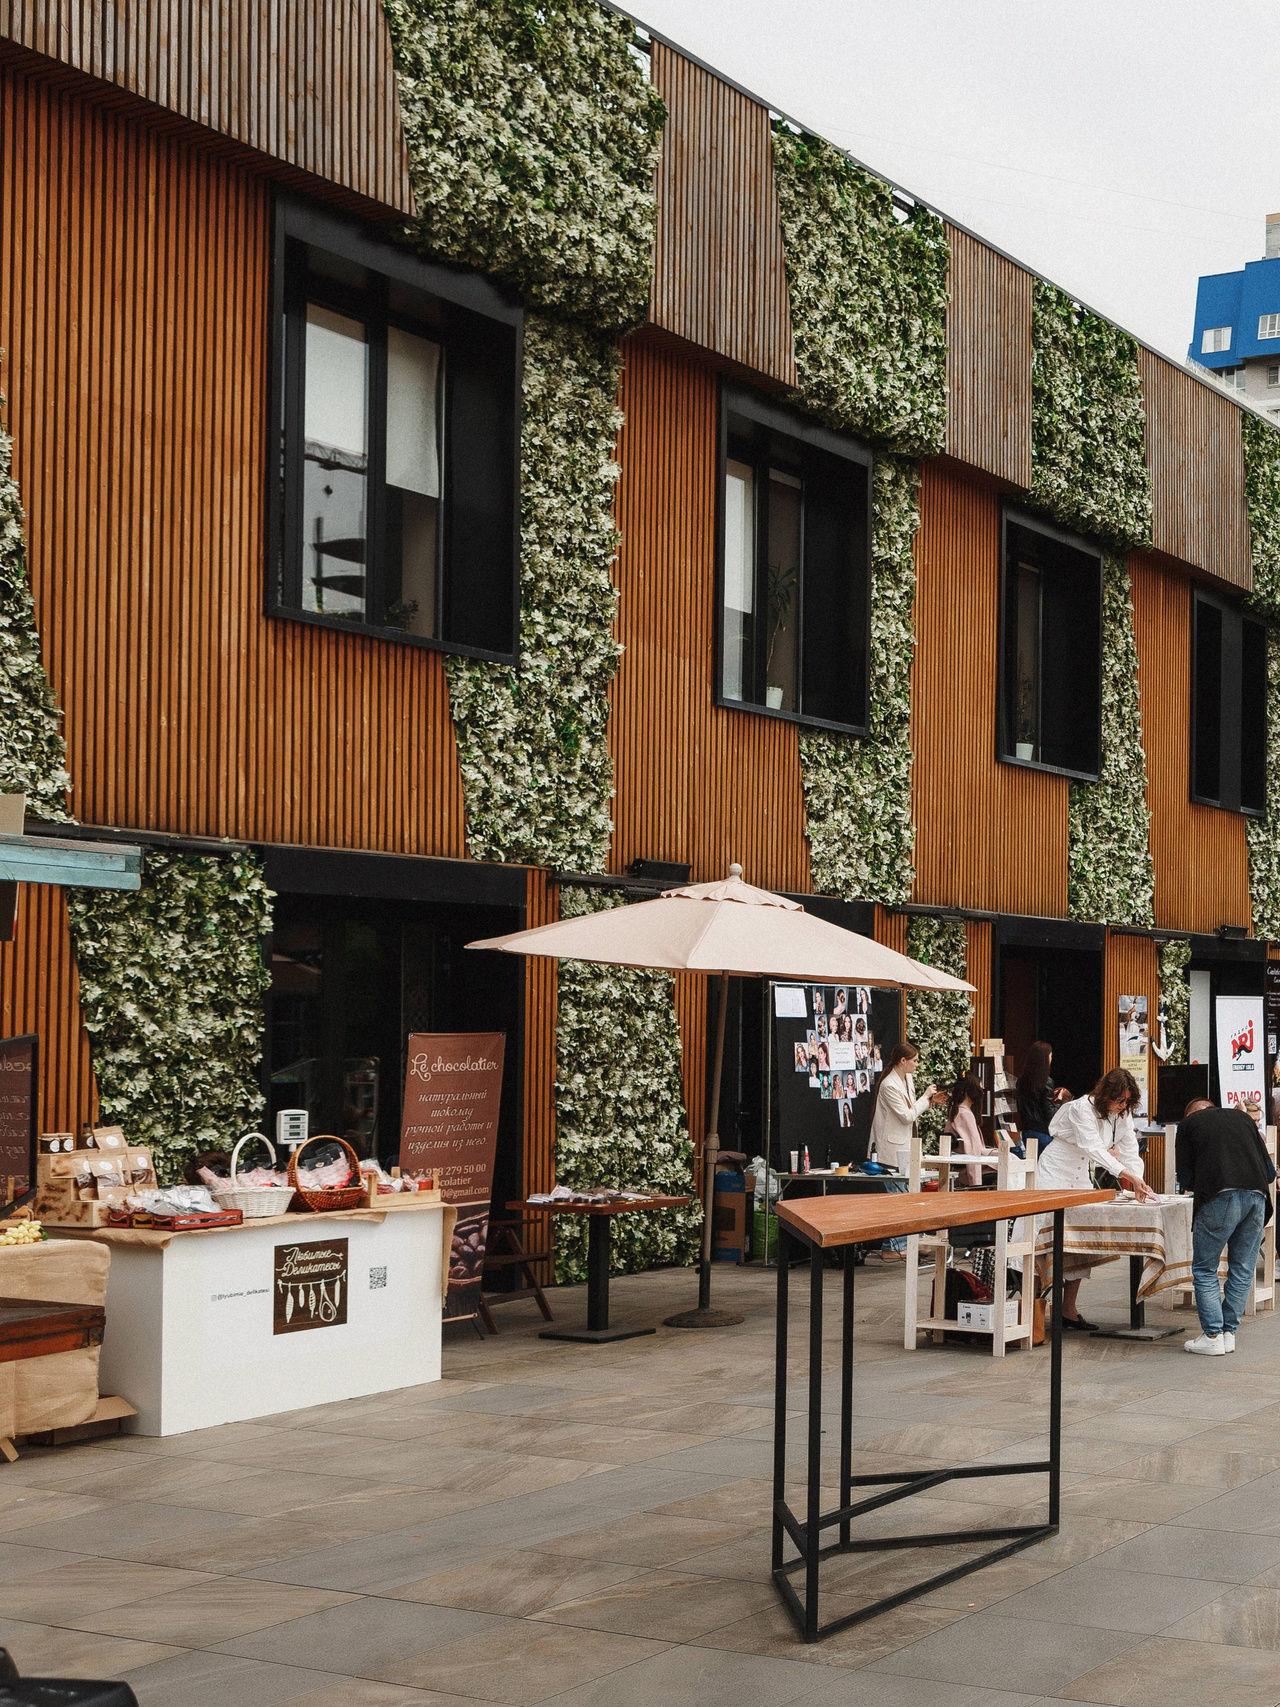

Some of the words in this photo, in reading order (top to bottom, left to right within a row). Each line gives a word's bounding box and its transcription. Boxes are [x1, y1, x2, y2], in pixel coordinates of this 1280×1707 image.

[431, 1055, 498, 1072] chocolatier
[418, 1089, 487, 1105] натуральный
[431, 1106, 474, 1120] шоколад
[405, 1122, 444, 1137] ручной
[446, 1119, 483, 1135] работы
[486, 1121, 492, 1129] и
[408, 1140, 449, 1154] изделия
[452, 1138, 463, 1151] из
[466, 1137, 488, 1146] него.
[426, 1167, 444, 1177] 98
[446, 1166, 461, 1176] 279
[463, 1164, 475, 1174] 50
[476, 1163, 486, 1173] 00
[283, 1246, 344, 1265] Любимые
[275, 1261, 341, 1278] Деликатесы
